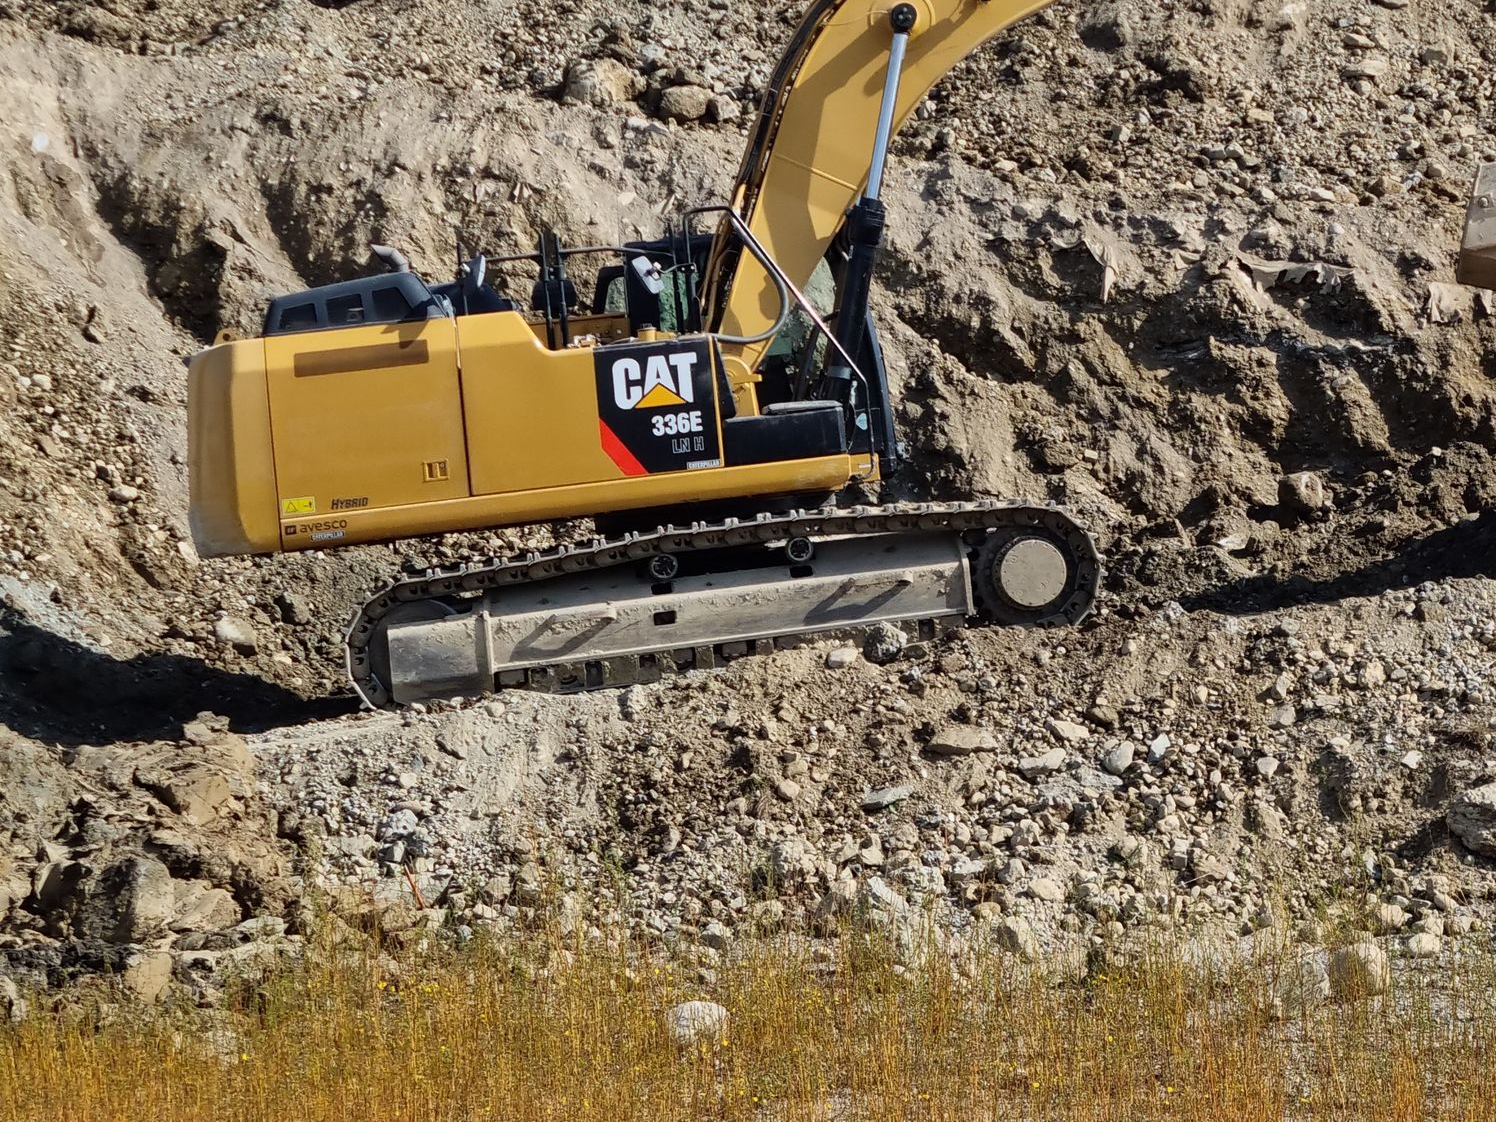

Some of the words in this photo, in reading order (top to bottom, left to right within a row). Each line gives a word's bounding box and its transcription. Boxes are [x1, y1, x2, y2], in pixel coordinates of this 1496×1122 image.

[611, 352, 697, 410] CAT
[651, 411, 703, 437] 336E
[672, 438, 690, 454] LN
[694, 436, 704, 451] H
[331, 497, 368, 510] HYBRID
[300, 519, 347, 533] avesco
